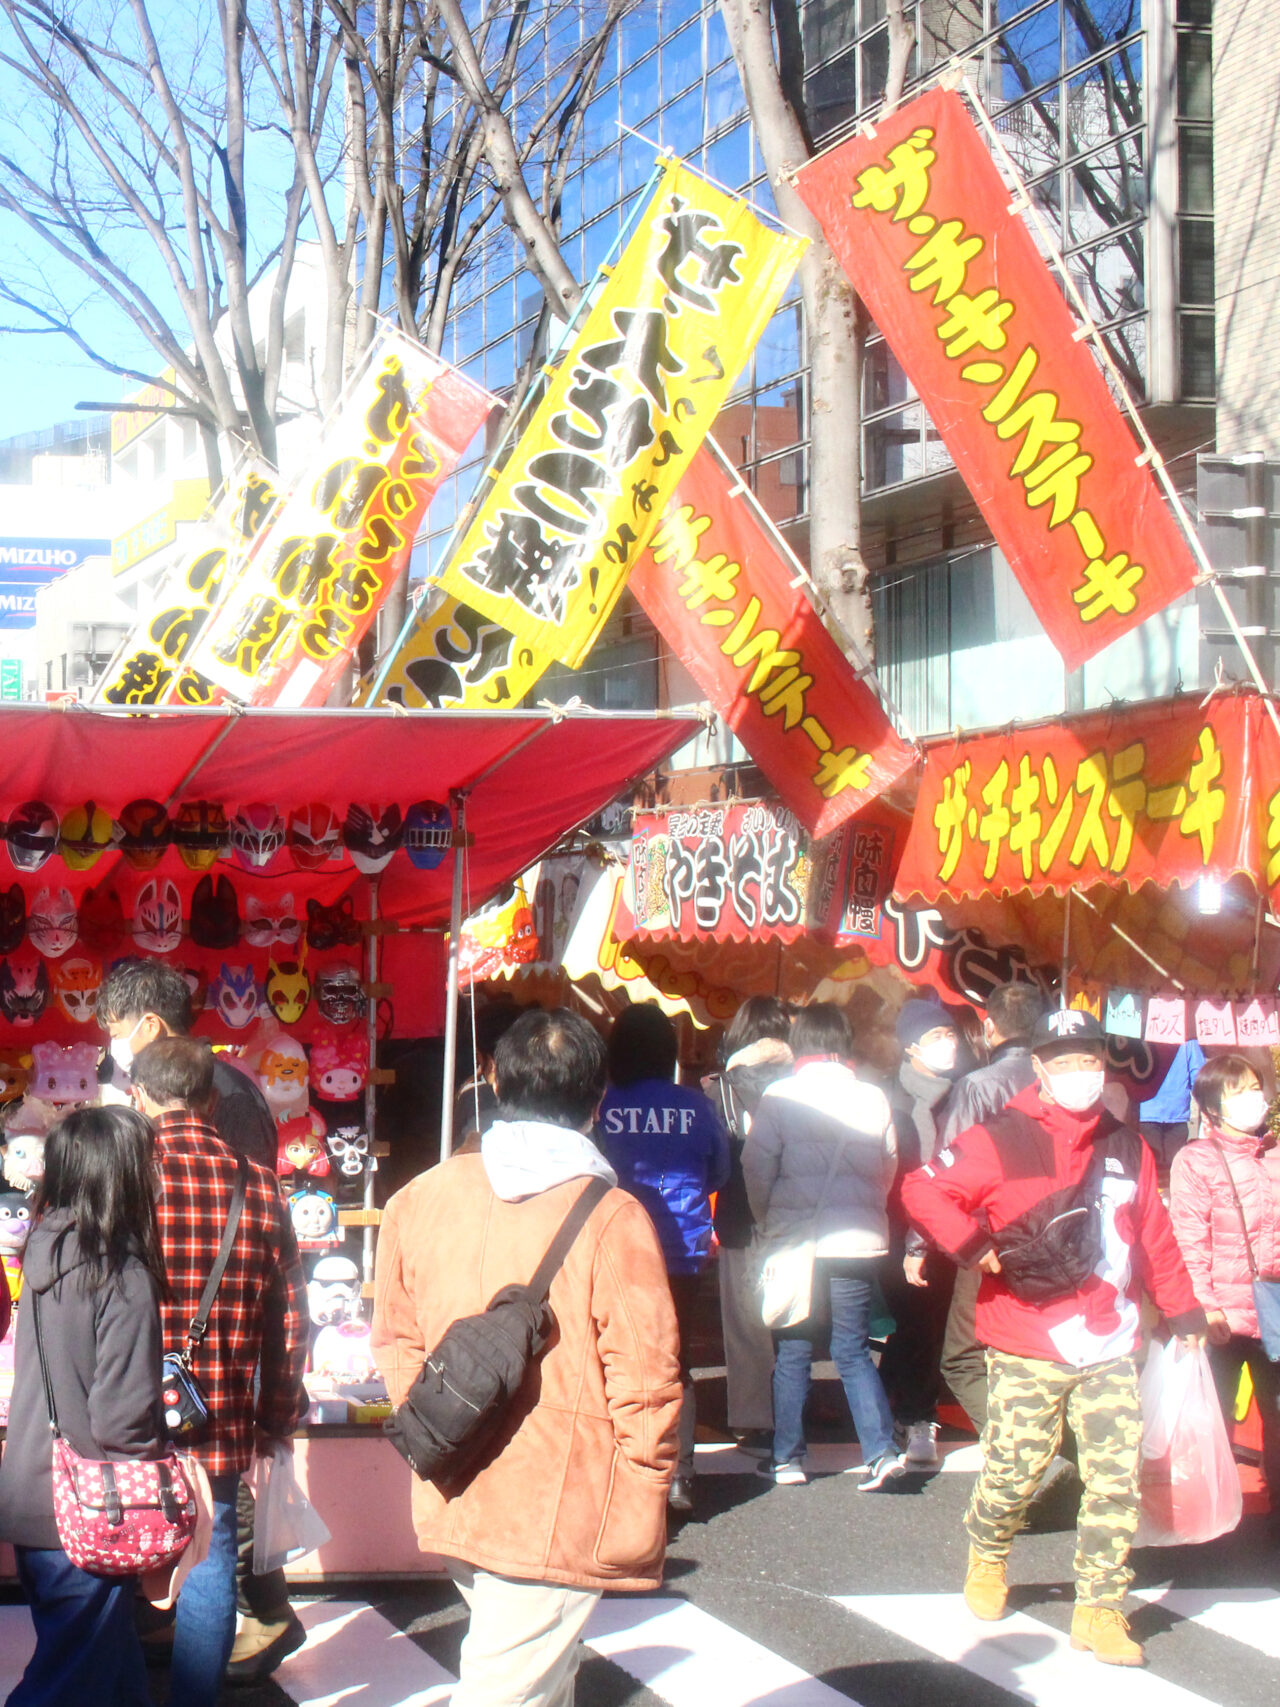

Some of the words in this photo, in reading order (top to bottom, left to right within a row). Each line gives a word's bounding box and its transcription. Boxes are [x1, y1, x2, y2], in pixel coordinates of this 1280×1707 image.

[852, 127, 1144, 623] ザ・チキンステーキ
[933, 724, 1225, 883] ザ・チキンステーキ
[605, 1107, 696, 1135] STAFF
